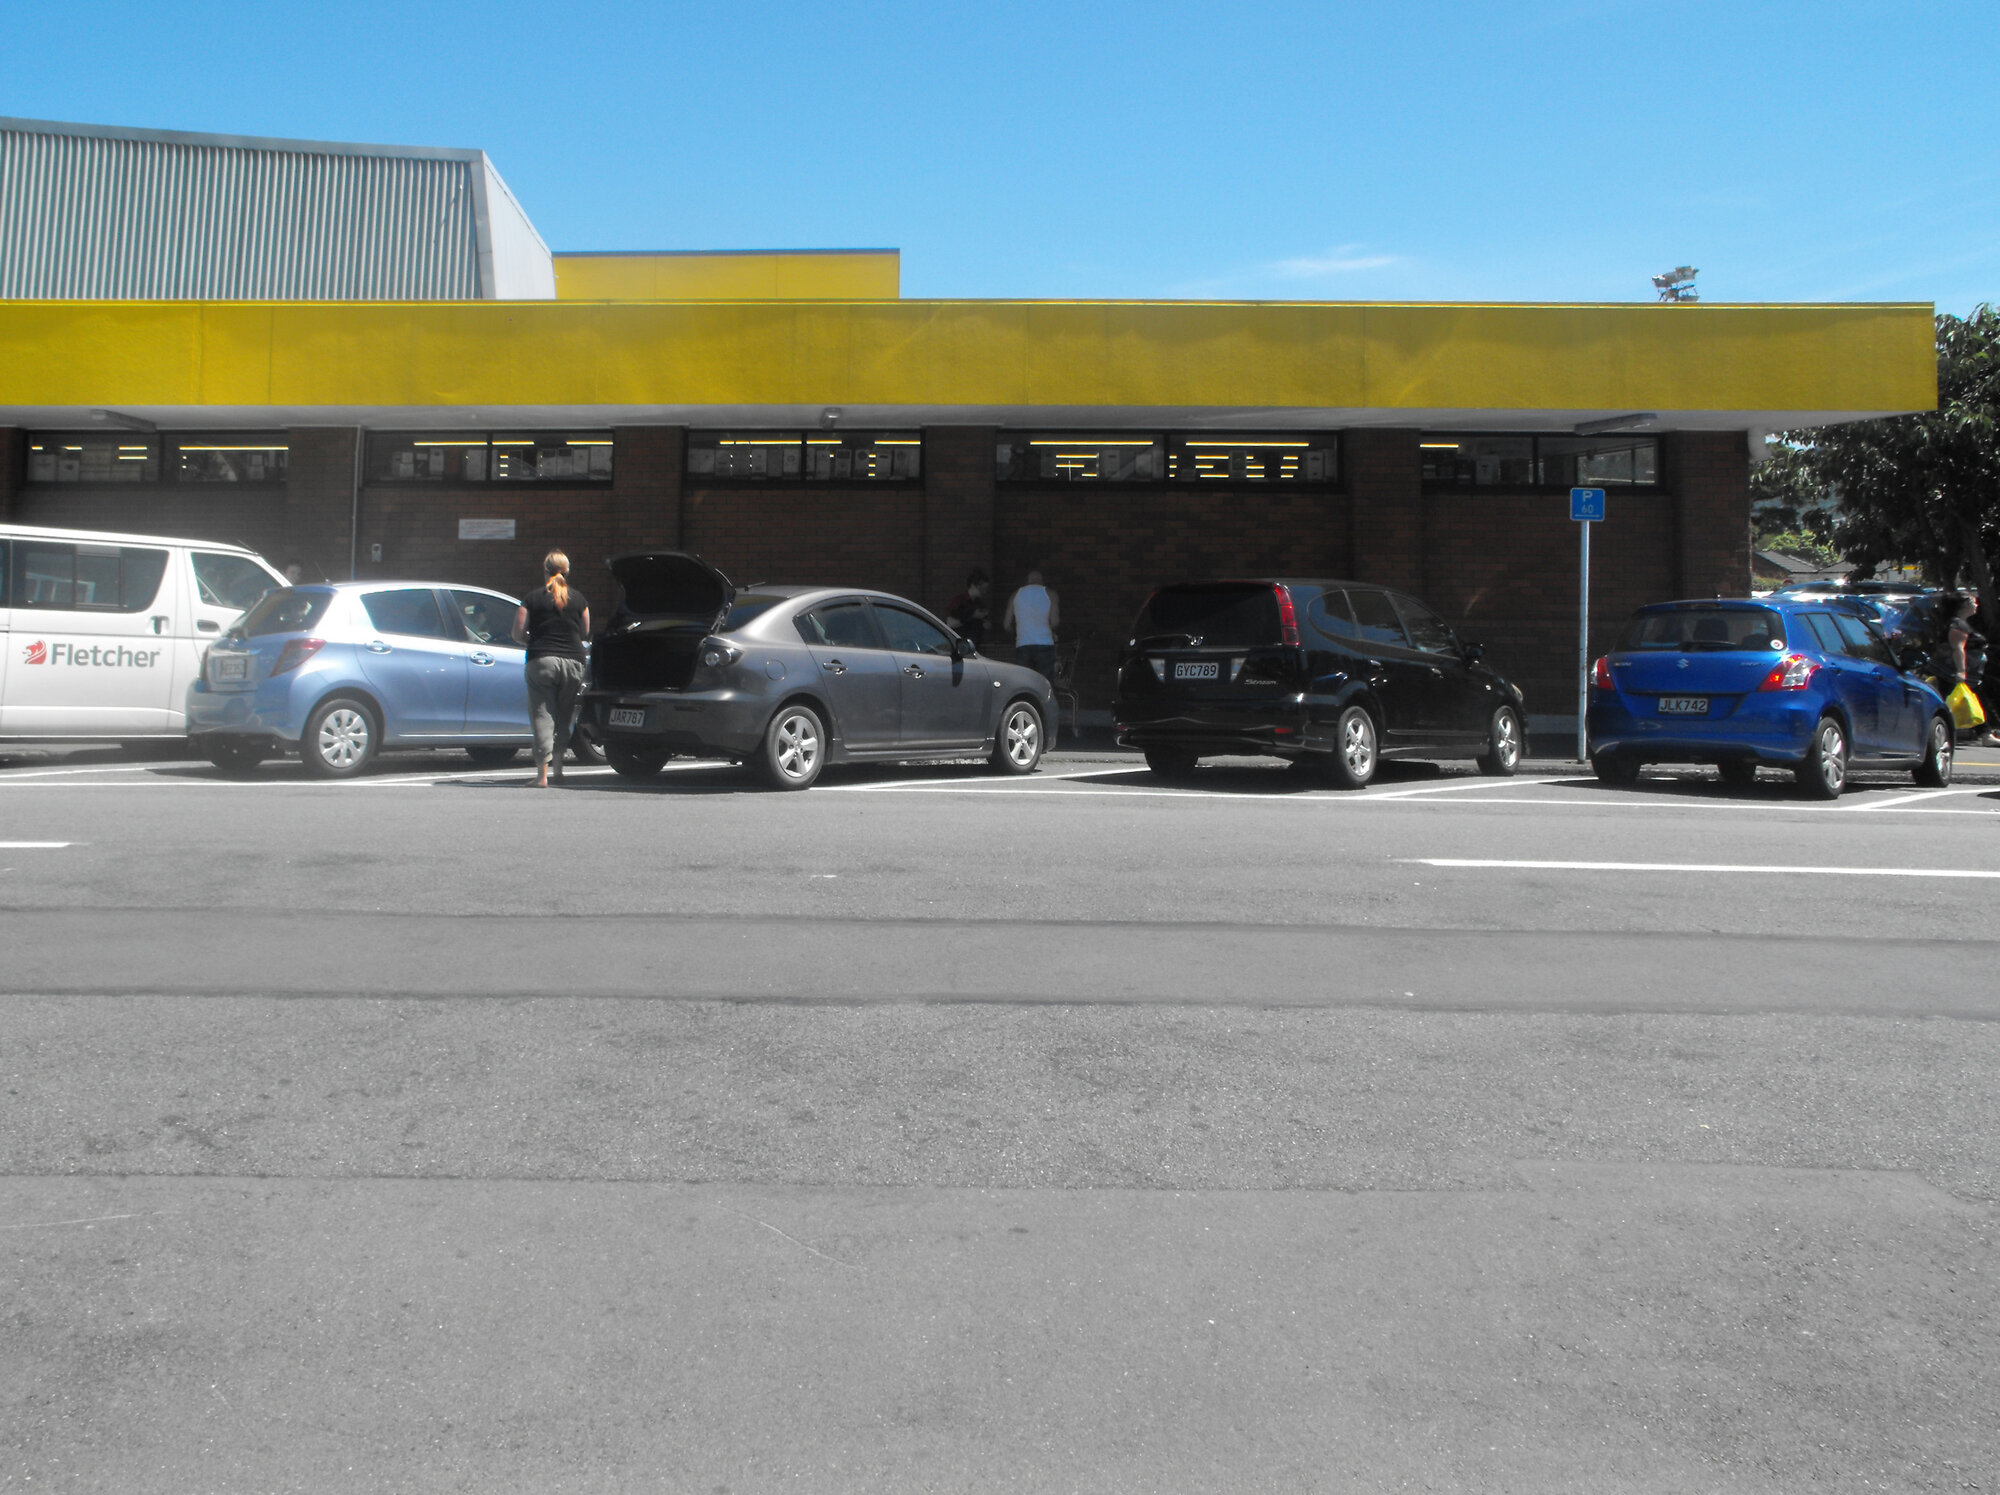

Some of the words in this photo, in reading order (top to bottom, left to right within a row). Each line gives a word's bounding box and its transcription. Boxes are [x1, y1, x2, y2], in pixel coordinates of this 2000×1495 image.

[1583, 490, 1593, 502] P
[51, 643, 161, 668] Fletcher
[1176, 665, 1217, 677] GYC789
[1660, 700, 1706, 711] JLK742
[610, 710, 644, 725] JAR787
